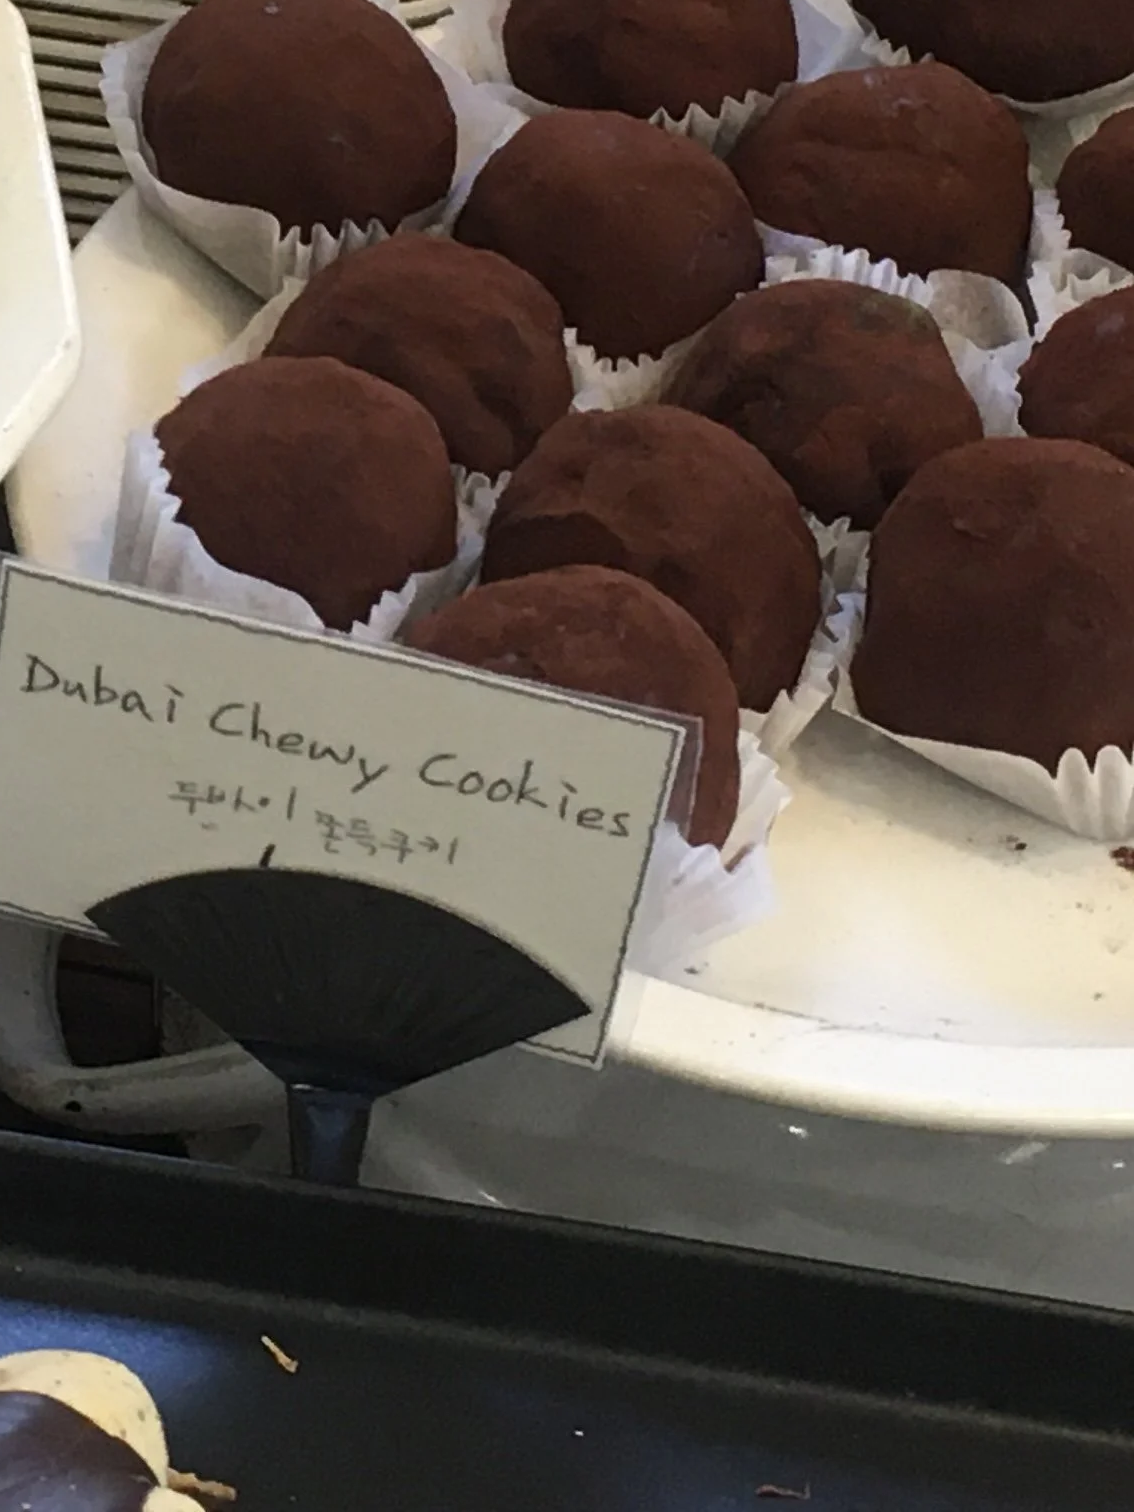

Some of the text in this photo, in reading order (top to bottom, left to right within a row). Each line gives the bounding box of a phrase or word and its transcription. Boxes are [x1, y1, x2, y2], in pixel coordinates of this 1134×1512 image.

[19, 653, 632, 839] Dubai Chewy Cookies
